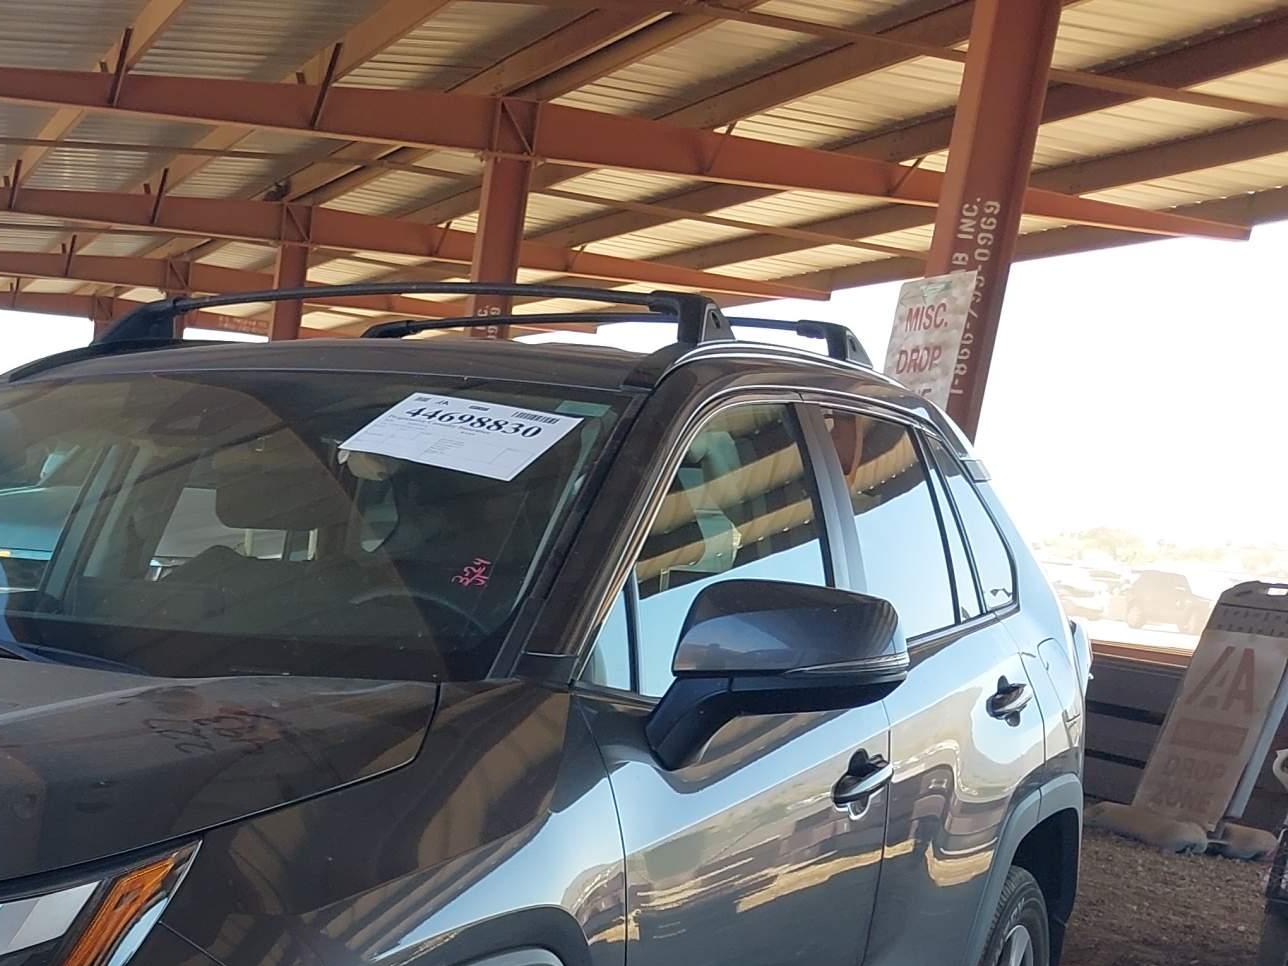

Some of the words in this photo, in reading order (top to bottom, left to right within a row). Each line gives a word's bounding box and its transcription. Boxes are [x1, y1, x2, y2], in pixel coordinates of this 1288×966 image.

[956, 197, 982, 240] INC.
[904, 302, 948, 333] MISC.
[895, 345, 942, 375] DROP
[405, 407, 542, 439] 44698830
